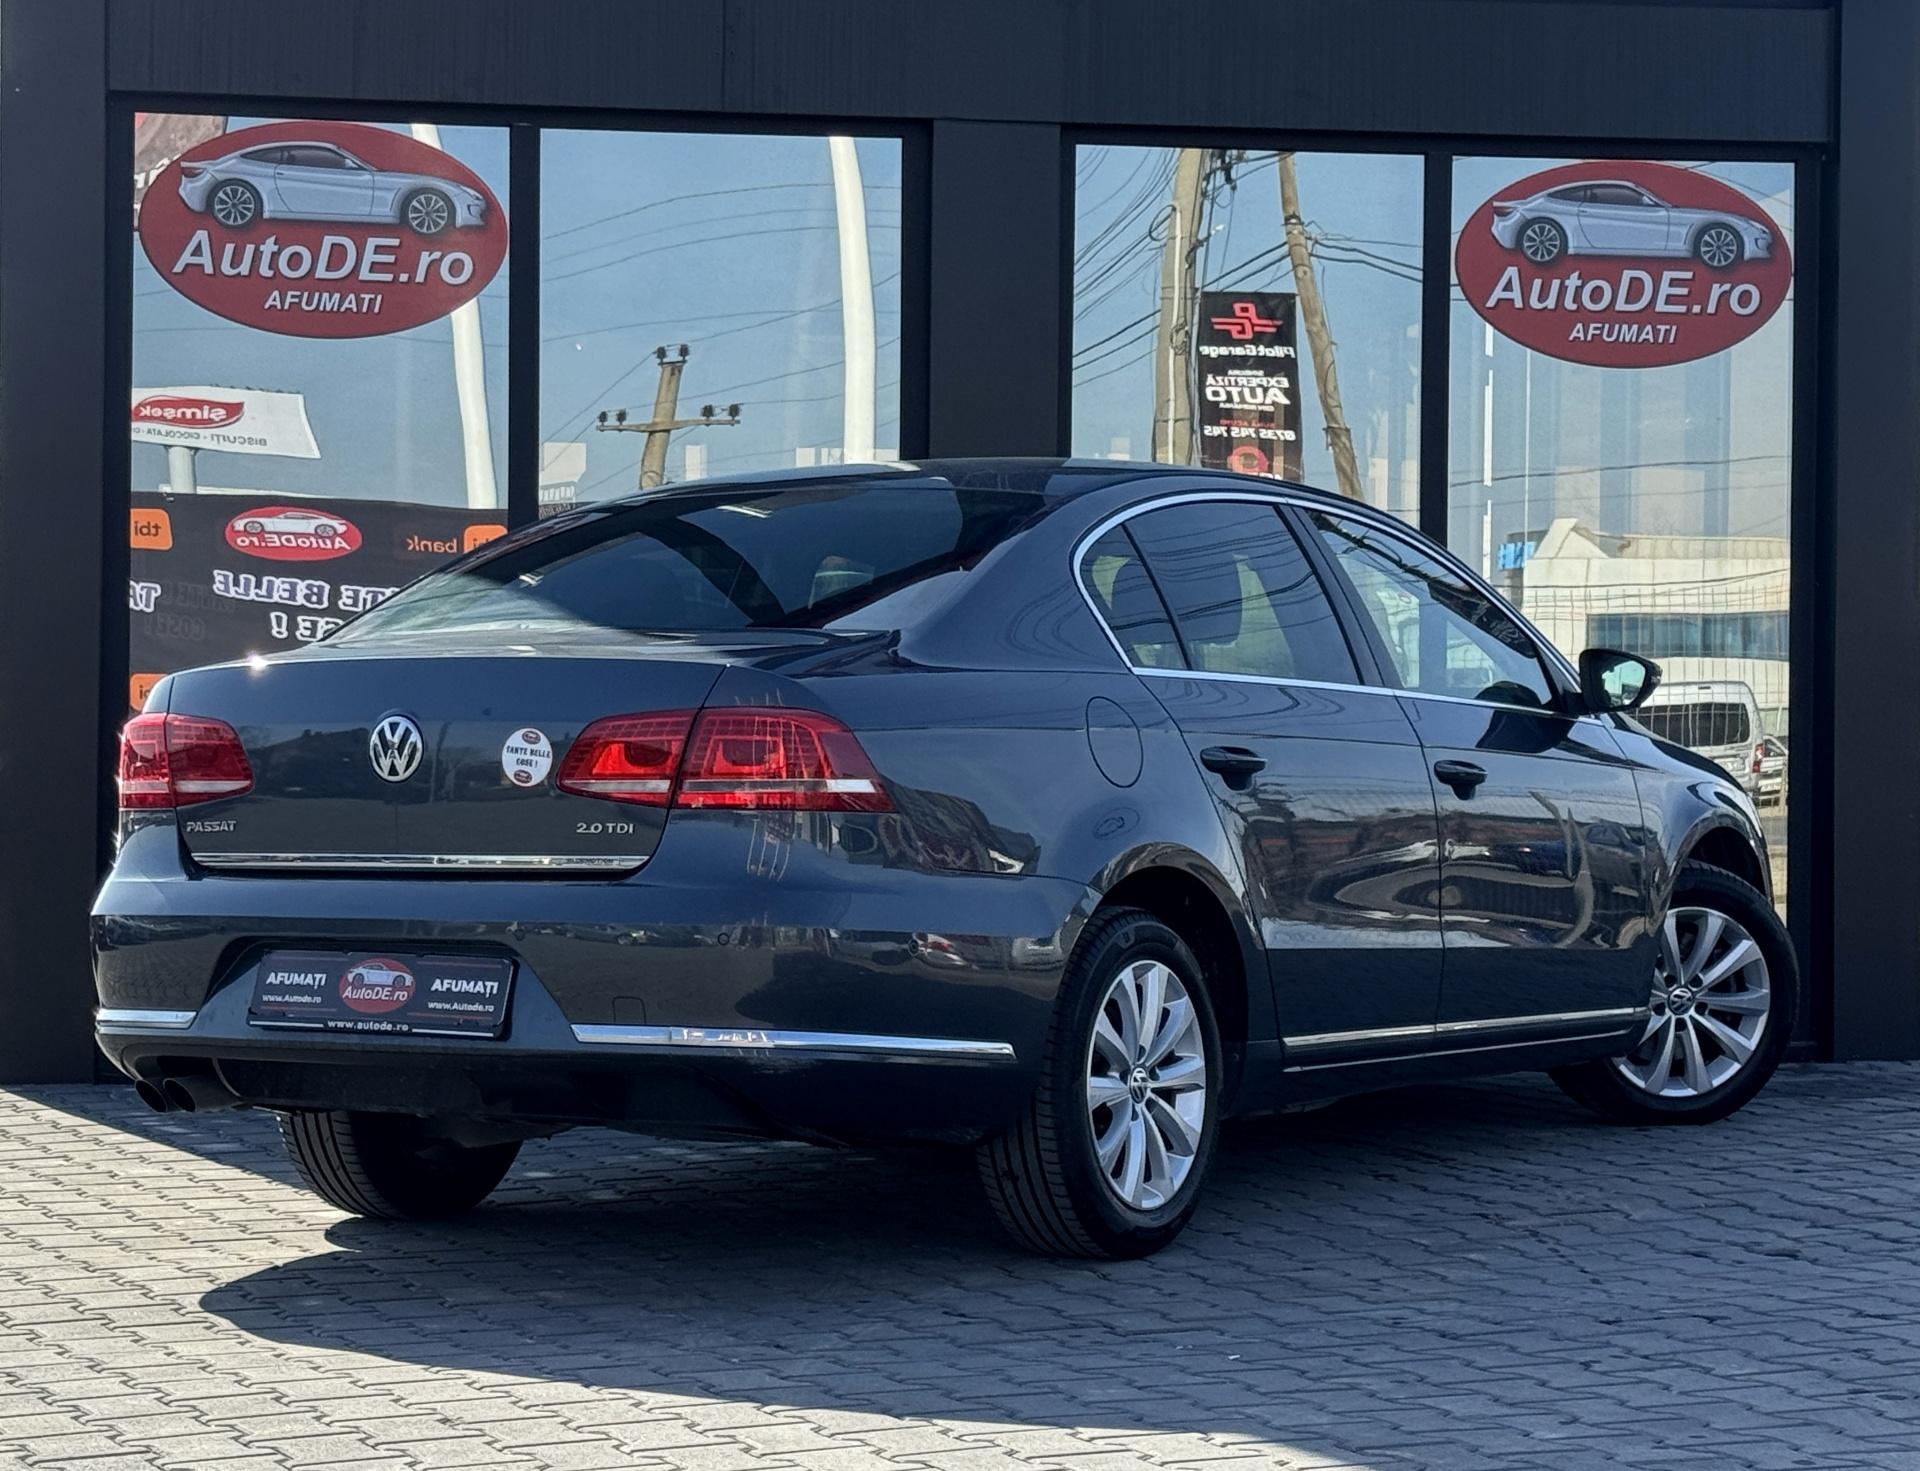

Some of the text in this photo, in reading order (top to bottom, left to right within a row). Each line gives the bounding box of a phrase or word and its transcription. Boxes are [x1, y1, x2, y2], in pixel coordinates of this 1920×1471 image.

[172, 229, 475, 286] AutoDE.ro
[1485, 265, 1762, 316] AutoDE.ro
[264, 290, 383, 314] AFUMATI
[1568, 322, 1678, 344] AFUMATI
[186, 820, 237, 832] PASSAT
[576, 822, 635, 834] 2.0 TDI
[342, 985, 408, 1002] AutoDE.ro
[327, 1020, 409, 1032] www.autode.ro
